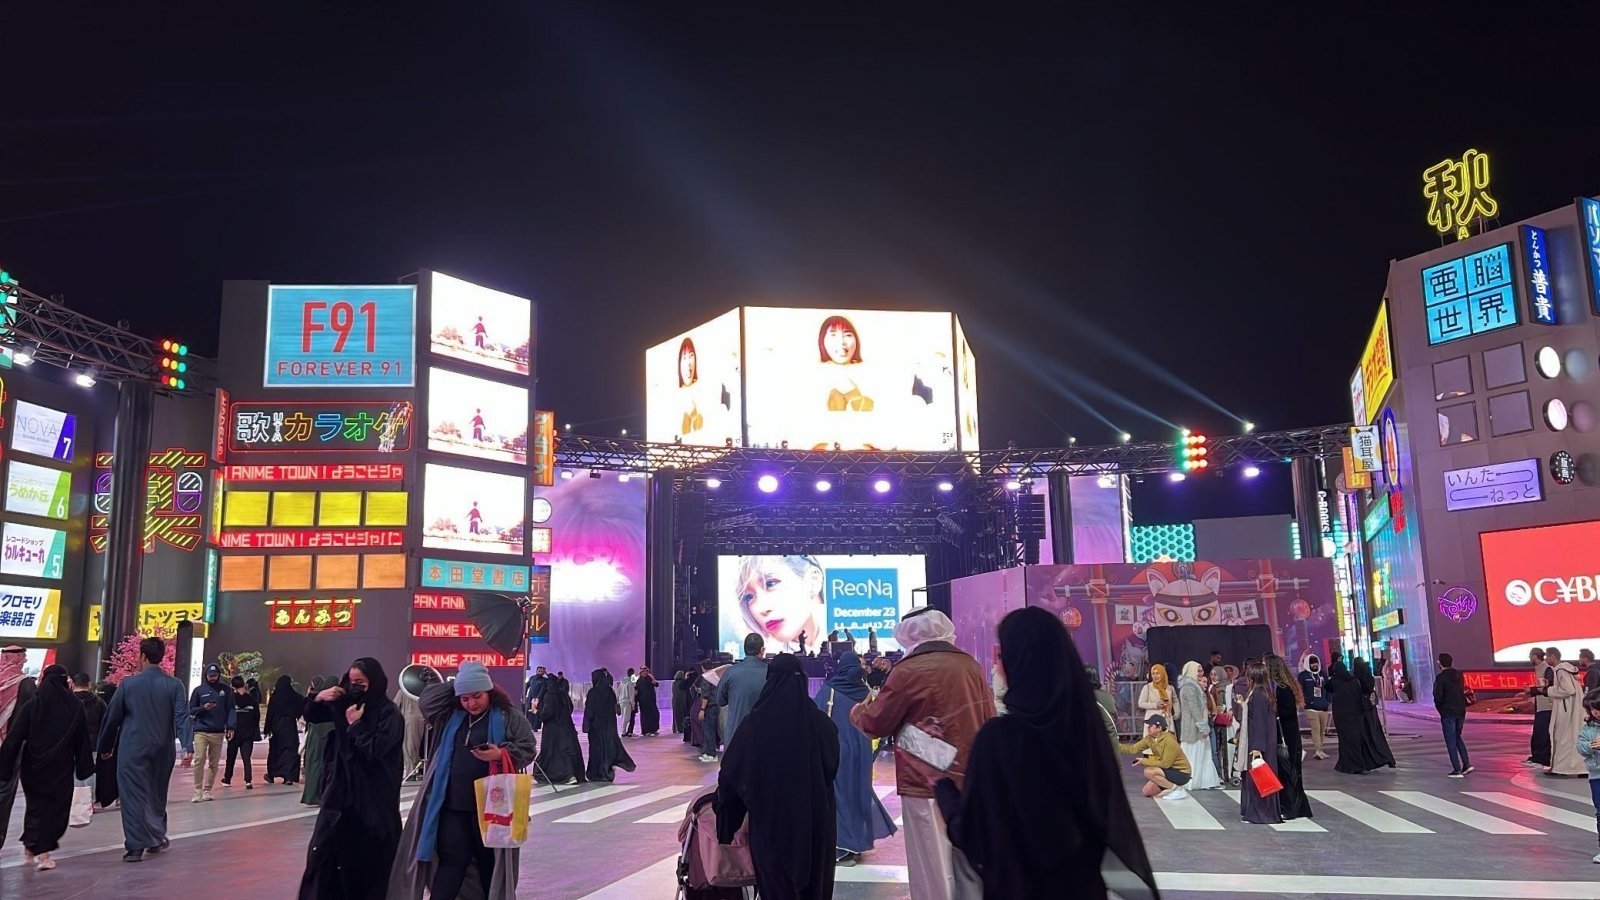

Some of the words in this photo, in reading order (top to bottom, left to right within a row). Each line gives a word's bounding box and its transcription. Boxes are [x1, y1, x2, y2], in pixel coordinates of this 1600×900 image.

[1423, 148, 1498, 232] 秋
[301, 301, 376, 353] F91
[277, 361, 372, 376] FOREVER
[381, 361, 401, 376] 91
[16, 414, 58, 440] NOVA
[237, 412, 270, 442] 歌
[62, 437, 72, 459] 7
[232, 466, 274, 479] ANIME
[279, 466, 318, 479] TOWN
[57, 496, 65, 518] 6
[255, 533, 295, 547] TOWN
[52, 554, 62, 577] 5
[428, 565, 525, 586] 本田堂書店
[832, 579, 893, 599] ReoNa
[2, 594, 43, 609] クロモリ
[0, 611, 36, 627] 楽器店
[275, 609, 351, 626] あんみつ
[834, 607, 882, 617] December
[882, 607, 896, 617] 23
[45, 613, 54, 637] 4
[421, 624, 459, 636] ANIME
[1498, 674, 1518, 688] to
